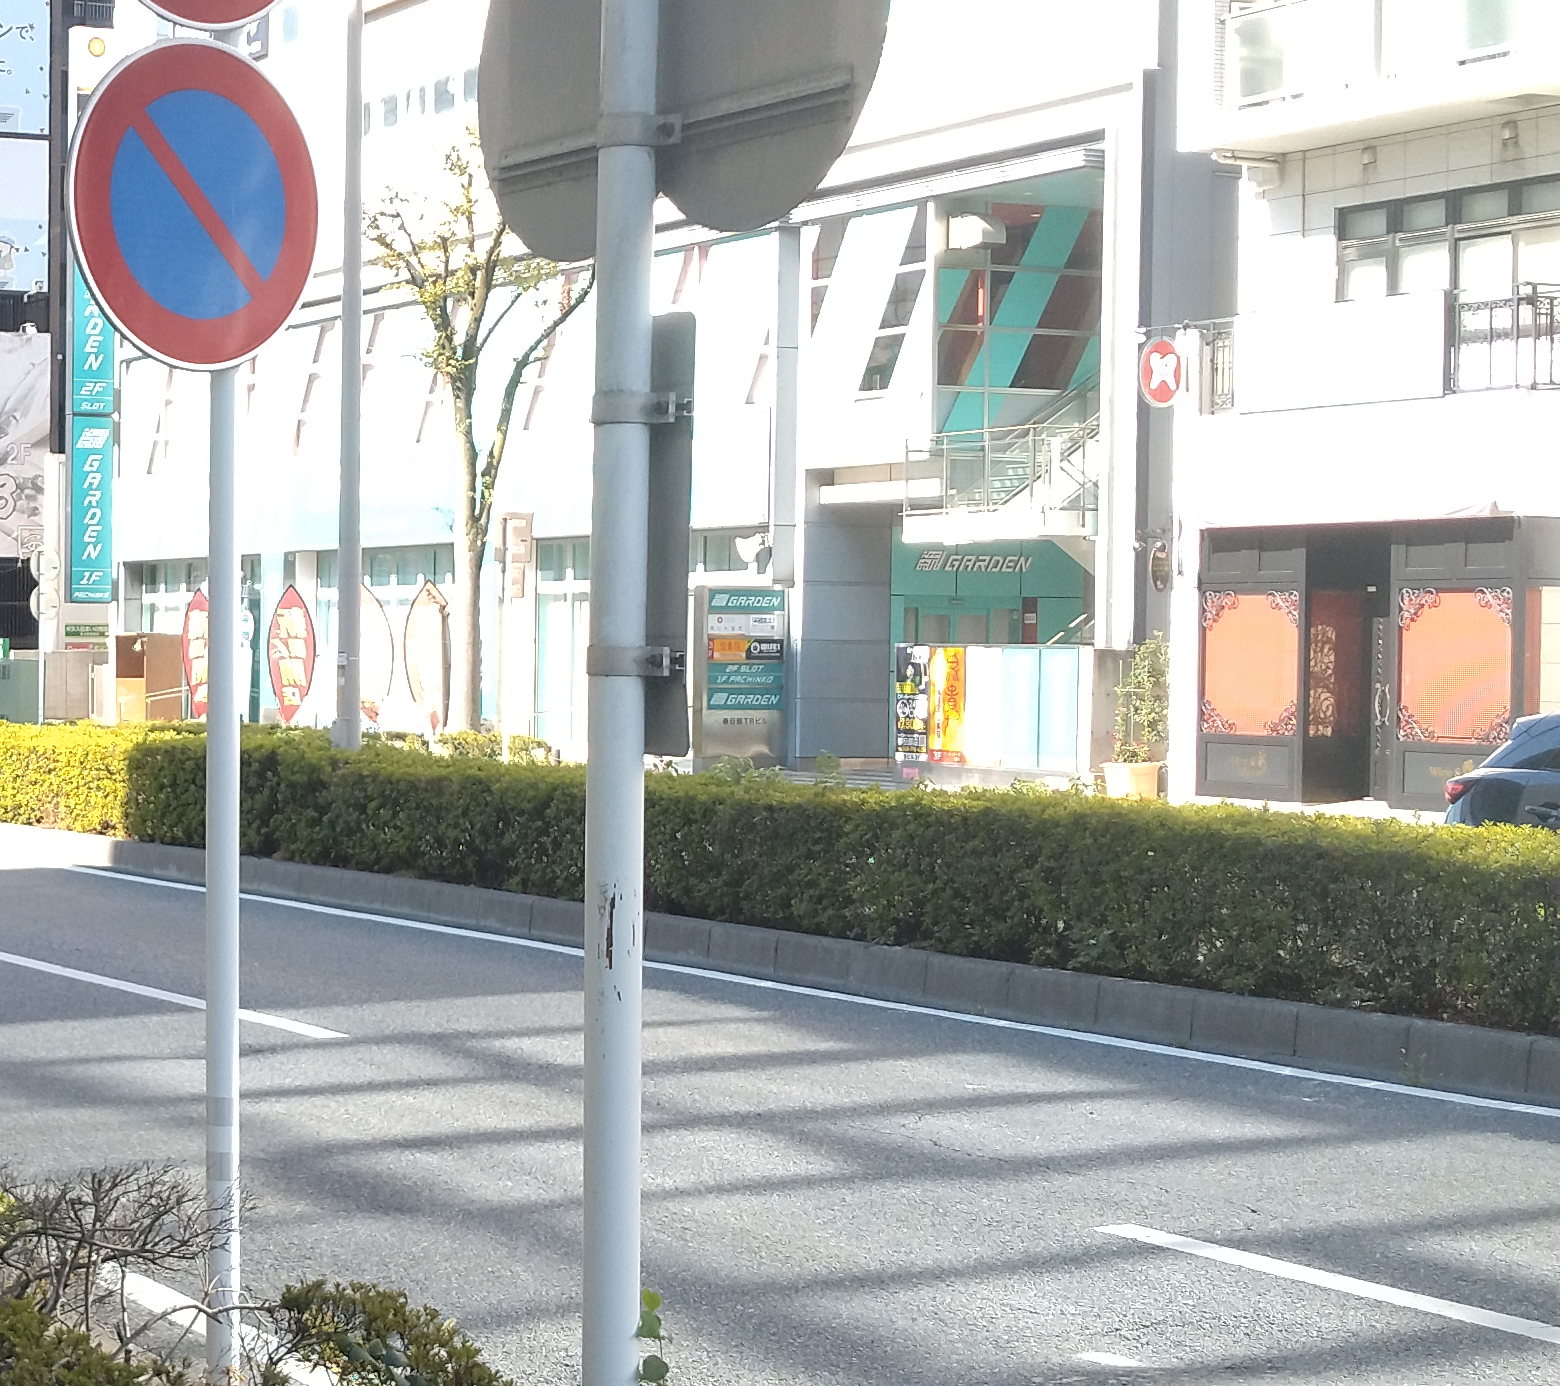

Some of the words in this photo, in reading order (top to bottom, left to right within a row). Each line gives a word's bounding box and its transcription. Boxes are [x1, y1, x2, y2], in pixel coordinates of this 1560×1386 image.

[80, 382, 107, 396] 2F
[80, 402, 106, 411] SLOT
[6, 443, 32, 466] 2F
[82, 454, 104, 560] GARDEN
[944, 555, 1033, 574] GARDEN
[80, 571, 104, 585] 1F
[728, 596, 781, 607] GARDEN
[725, 665, 739, 673] 2F
[741, 665, 765, 673] SLOT
[716, 675, 728, 683] 1F
[729, 675, 774, 684] PACHINKO
[726, 694, 780, 705] GARDEN
